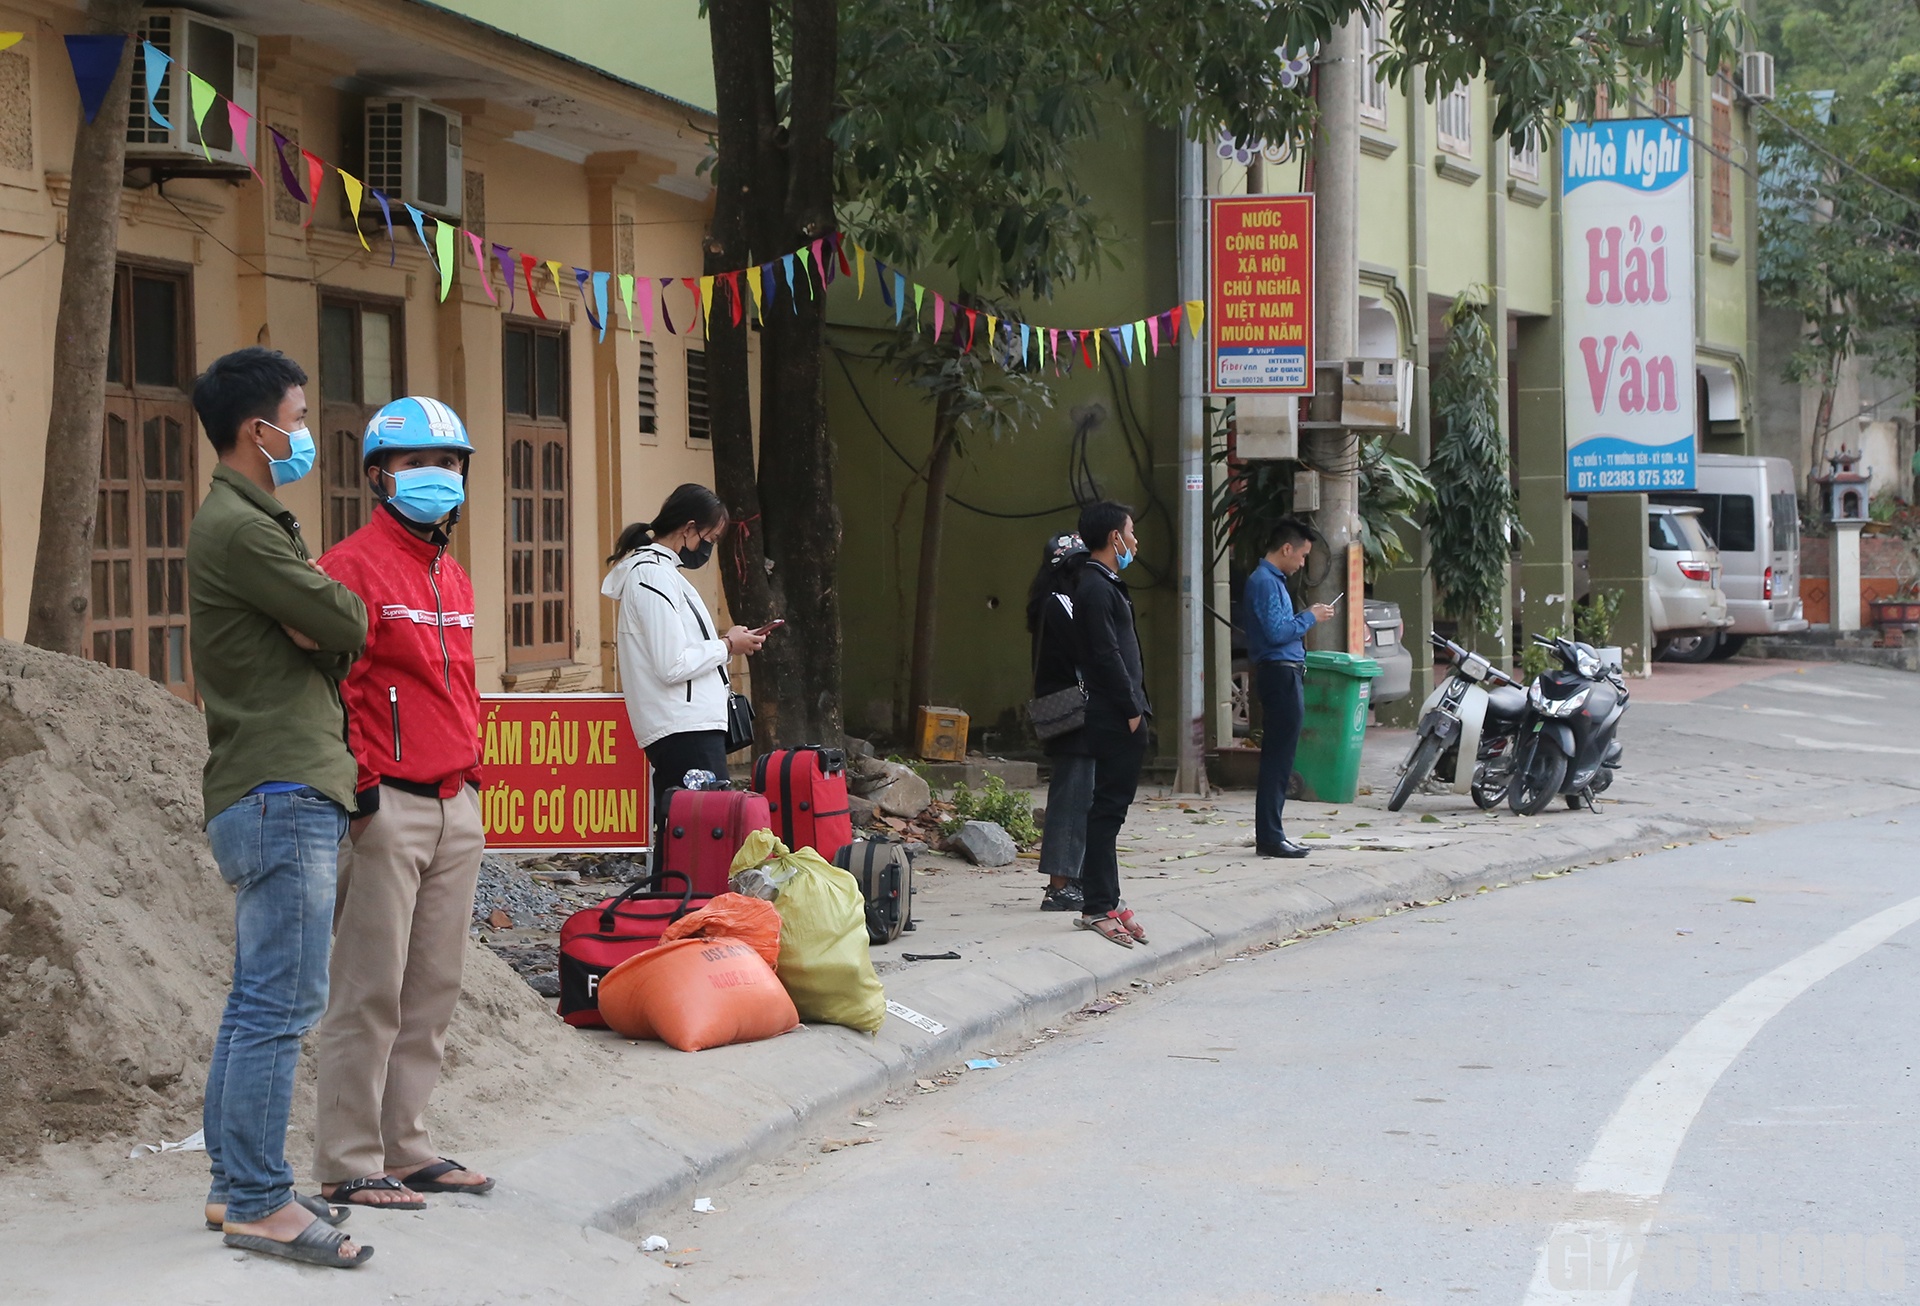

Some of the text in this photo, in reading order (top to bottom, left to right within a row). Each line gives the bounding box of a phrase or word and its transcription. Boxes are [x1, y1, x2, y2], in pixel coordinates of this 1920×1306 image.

[1568, 128, 1618, 178] Nhà
[1242, 208, 1282, 228] NƯỚC
[1225, 230, 1299, 254] CỘNG HÒA
[1237, 254, 1286, 277] XÃ HỘI
[1585, 214, 1669, 305] Hải
[1223, 275, 1301, 297] CHỦ NGHĨA
[1226, 300, 1294, 322] VIỆT NAM
[1221, 322, 1303, 342] MUÔN NĂM
[1579, 330, 1680, 416] Vân
[1578, 469, 1685, 488] ĐT: 02383 875 332
[530, 710, 579, 775] ĐẬU
[586, 720, 617, 765] XE
[532, 785, 566, 835] CƠ
[573, 788, 637, 839] QUAN
